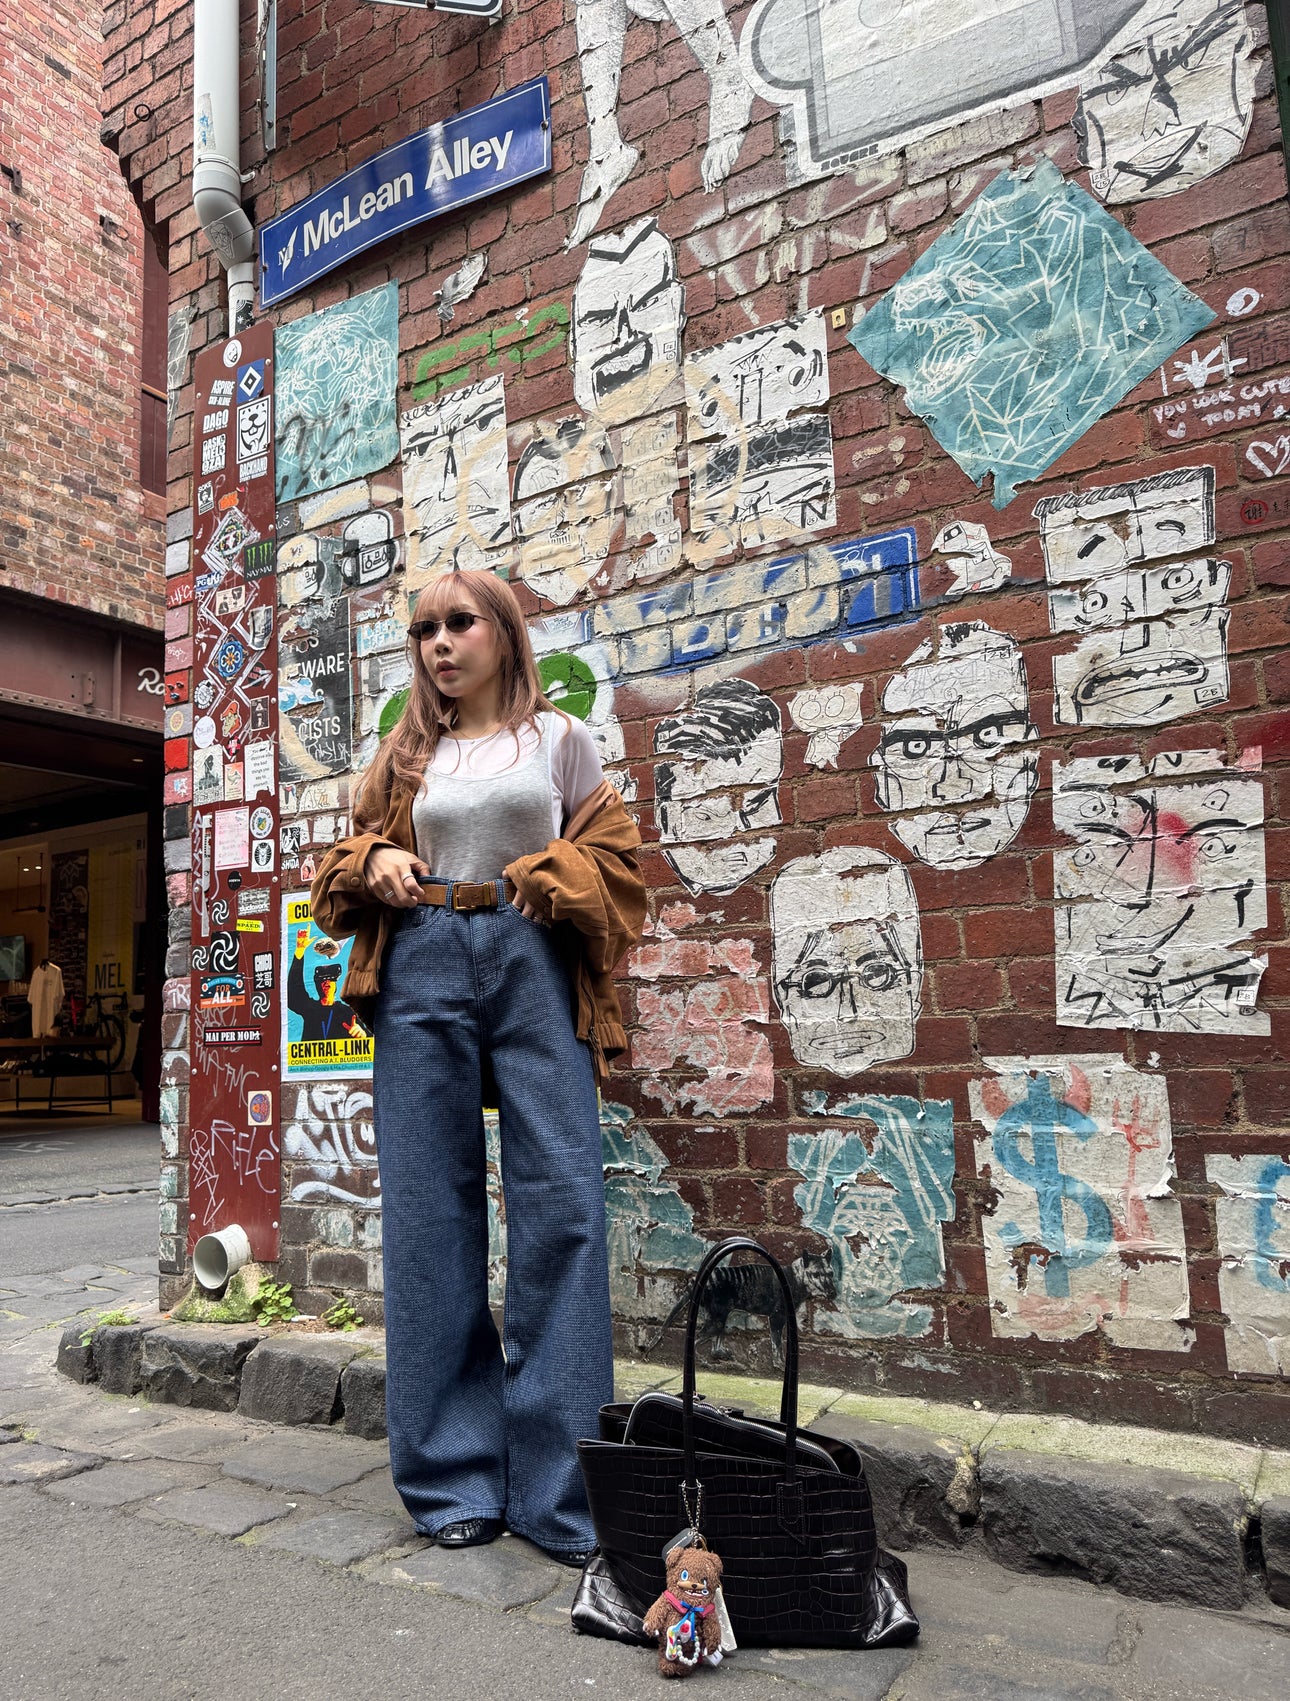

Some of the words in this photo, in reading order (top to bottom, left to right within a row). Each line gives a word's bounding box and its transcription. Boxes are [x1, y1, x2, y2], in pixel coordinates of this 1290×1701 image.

[303, 171, 413, 257] McLean
[425, 130, 513, 190] Alley
[1152, 400, 1187, 424] YOU
[1192, 388, 1235, 411] LOOK
[1201, 402, 1261, 426] TODAY
[203, 409, 229, 431] DAGO
[299, 652, 345, 679] WARE
[292, 715, 341, 741] CISTS
[294, 903, 312, 919] CO
[95, 962, 126, 990] MEL
[212, 990, 233, 1004] ALL
[216, 984, 230, 992] FOR
[205, 1032, 219, 1042] MAI
[221, 1031, 236, 1041] PER
[237, 1030, 260, 1041] MODA
[291, 1039, 370, 1058] CENTRAL-LINK
